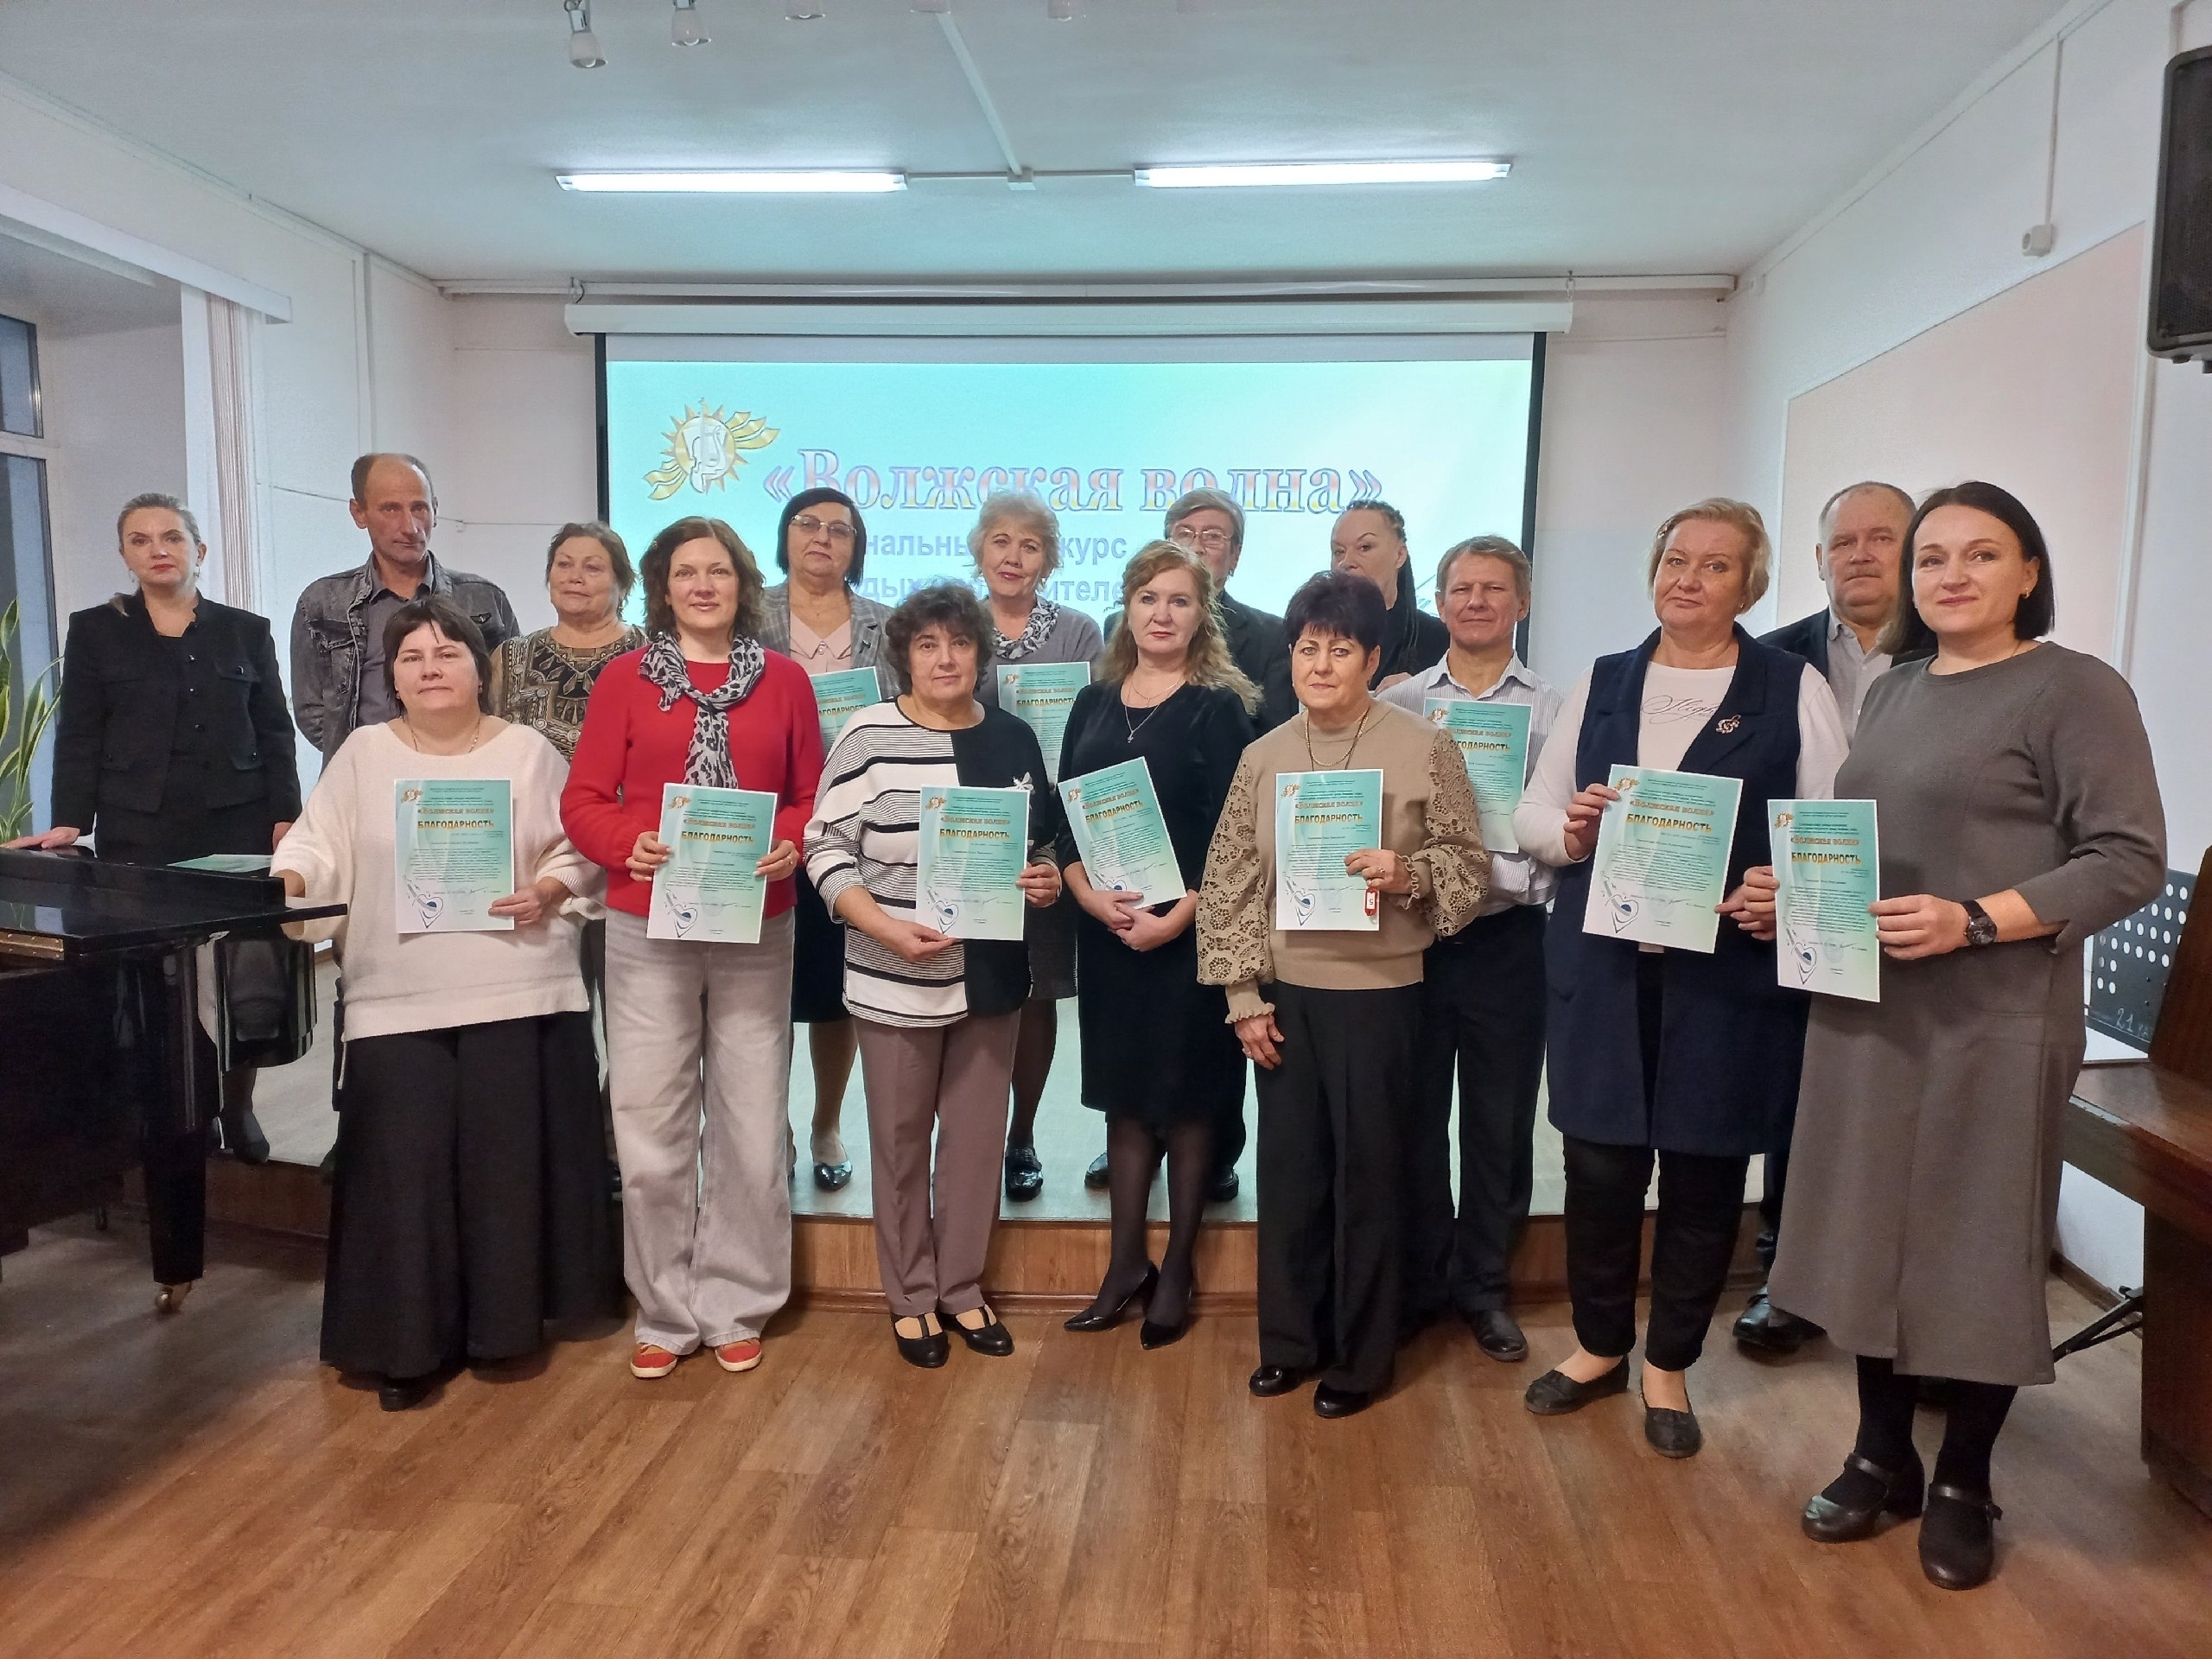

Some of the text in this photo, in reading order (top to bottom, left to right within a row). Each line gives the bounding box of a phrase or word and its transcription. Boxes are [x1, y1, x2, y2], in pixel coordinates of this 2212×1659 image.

[763, 448, 1382, 514] «Волжская волна»
[866, 535, 1127, 565] нальны курс
[1042, 580, 1124, 601] ителе
[1457, 741, 1510, 752] ГОДАРНОСТЬ
[1294, 813, 1363, 823] БЛАГОДАРНОСТЬ
[1626, 813, 1713, 833] БЛАГОДАРНОСТЬ
[417, 820, 494, 830] БЛАГОДАРНОСТЬ
[681, 830, 753, 843] БЛАГОДАРНОСТЬ
[939, 829, 1010, 839] БЛАГОДАРНОСТЬ
[1791, 851, 1861, 864] БЛАГОДАРНОСТЬ
